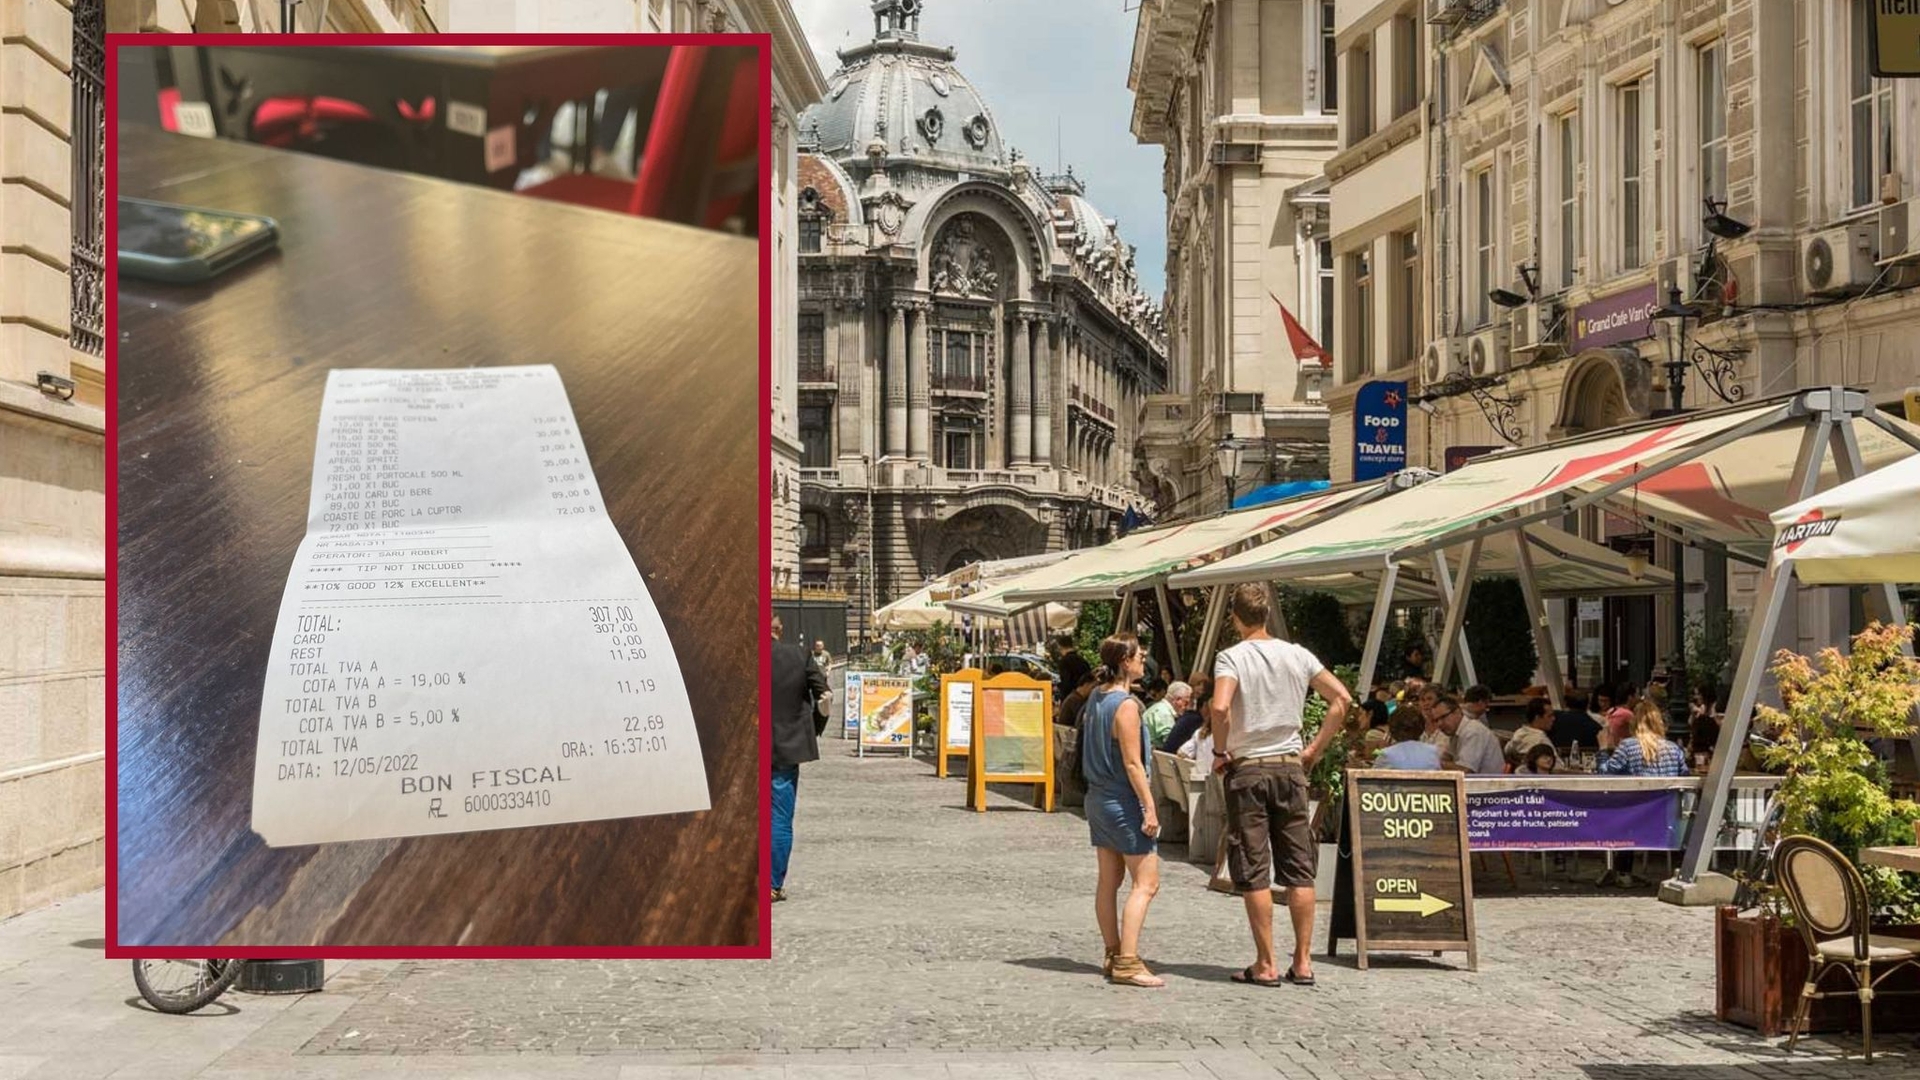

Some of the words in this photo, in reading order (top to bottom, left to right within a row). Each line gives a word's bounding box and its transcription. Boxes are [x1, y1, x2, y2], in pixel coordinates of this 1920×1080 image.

[1588, 315, 1611, 334] Grand
[1611, 310, 1628, 328] Cafe
[1628, 307, 1644, 322] Van
[1645, 302, 1657, 319] Go
[1364, 415, 1400, 427] FOOD
[1358, 442, 1405, 454] TRAVEL
[326, 474, 356, 482] FRESH
[360, 473, 372, 481] DE
[376, 471, 426, 480] PORTOCALE
[430, 470, 448, 478] 500
[452, 470, 464, 478] ML
[382, 480, 400, 488] BUC
[325, 492, 360, 501] PLATOU
[365, 490, 389, 499] CARU
[393, 489, 405, 497] CU
[409, 488, 433, 496] BERE
[382, 499, 400, 508] BUC
[323, 511, 359, 522] COASTE
[364, 510, 376, 520] DE
[382, 509, 405, 518] PORC
[411, 508, 423, 516] LA
[427, 505, 463, 515] CUPTOR
[382, 520, 400, 529] BUC
[589, 505, 596, 513] B
[347, 582, 376, 590] GOOD
[384, 581, 404, 589] 12%
[298, 614, 341, 633] TOTAL:
[588, 606, 633, 624] 307,00
[293, 633, 326, 645] CARD
[593, 623, 638, 634] 307,00
[290, 647, 323, 660] REST
[612, 635, 642, 647] 0,00
[290, 662, 329, 676] TOTAL
[339, 661, 362, 673] TVA
[370, 660, 378, 672] A
[610, 648, 647, 661] 11,50
[303, 679, 336, 694] COTA
[346, 677, 370, 691] TVA
[377, 676, 385, 689] A
[411, 673, 451, 688] 19,00
[457, 671, 467, 685] %
[285, 698, 326, 714] TOTAL
[336, 696, 360, 710] TVA
[368, 694, 377, 709] B
[617, 678, 656, 694] 11,19
[299, 717, 334, 734] COTA
[343, 714, 368, 731] TVA
[376, 713, 385, 729] B
[409, 709, 444, 728] 5,00
[451, 708, 460, 723] %
[281, 740, 323, 757] TOTAL
[333, 736, 359, 753] TVA
[623, 715, 664, 733] 22,69
[278, 762, 321, 781] DATA:
[333, 754, 419, 777] 12/05/2022
[562, 742, 594, 758] ORA:
[604, 736, 667, 755] 16:37:01
[401, 774, 452, 794] BON
[472, 765, 572, 789] FISCAL
[464, 789, 551, 813] 6000333410
[1361, 793, 1452, 814] SOUVENIR
[1483, 795, 1524, 804] room-ul
[1471, 810, 1502, 818] flipchart
[1543, 810, 1567, 819] pentru
[1472, 819, 1496, 828] Cappy
[1548, 820, 1579, 828] patiserie
[1384, 819, 1434, 839] SHOP
[1376, 879, 1417, 893] OPEN
